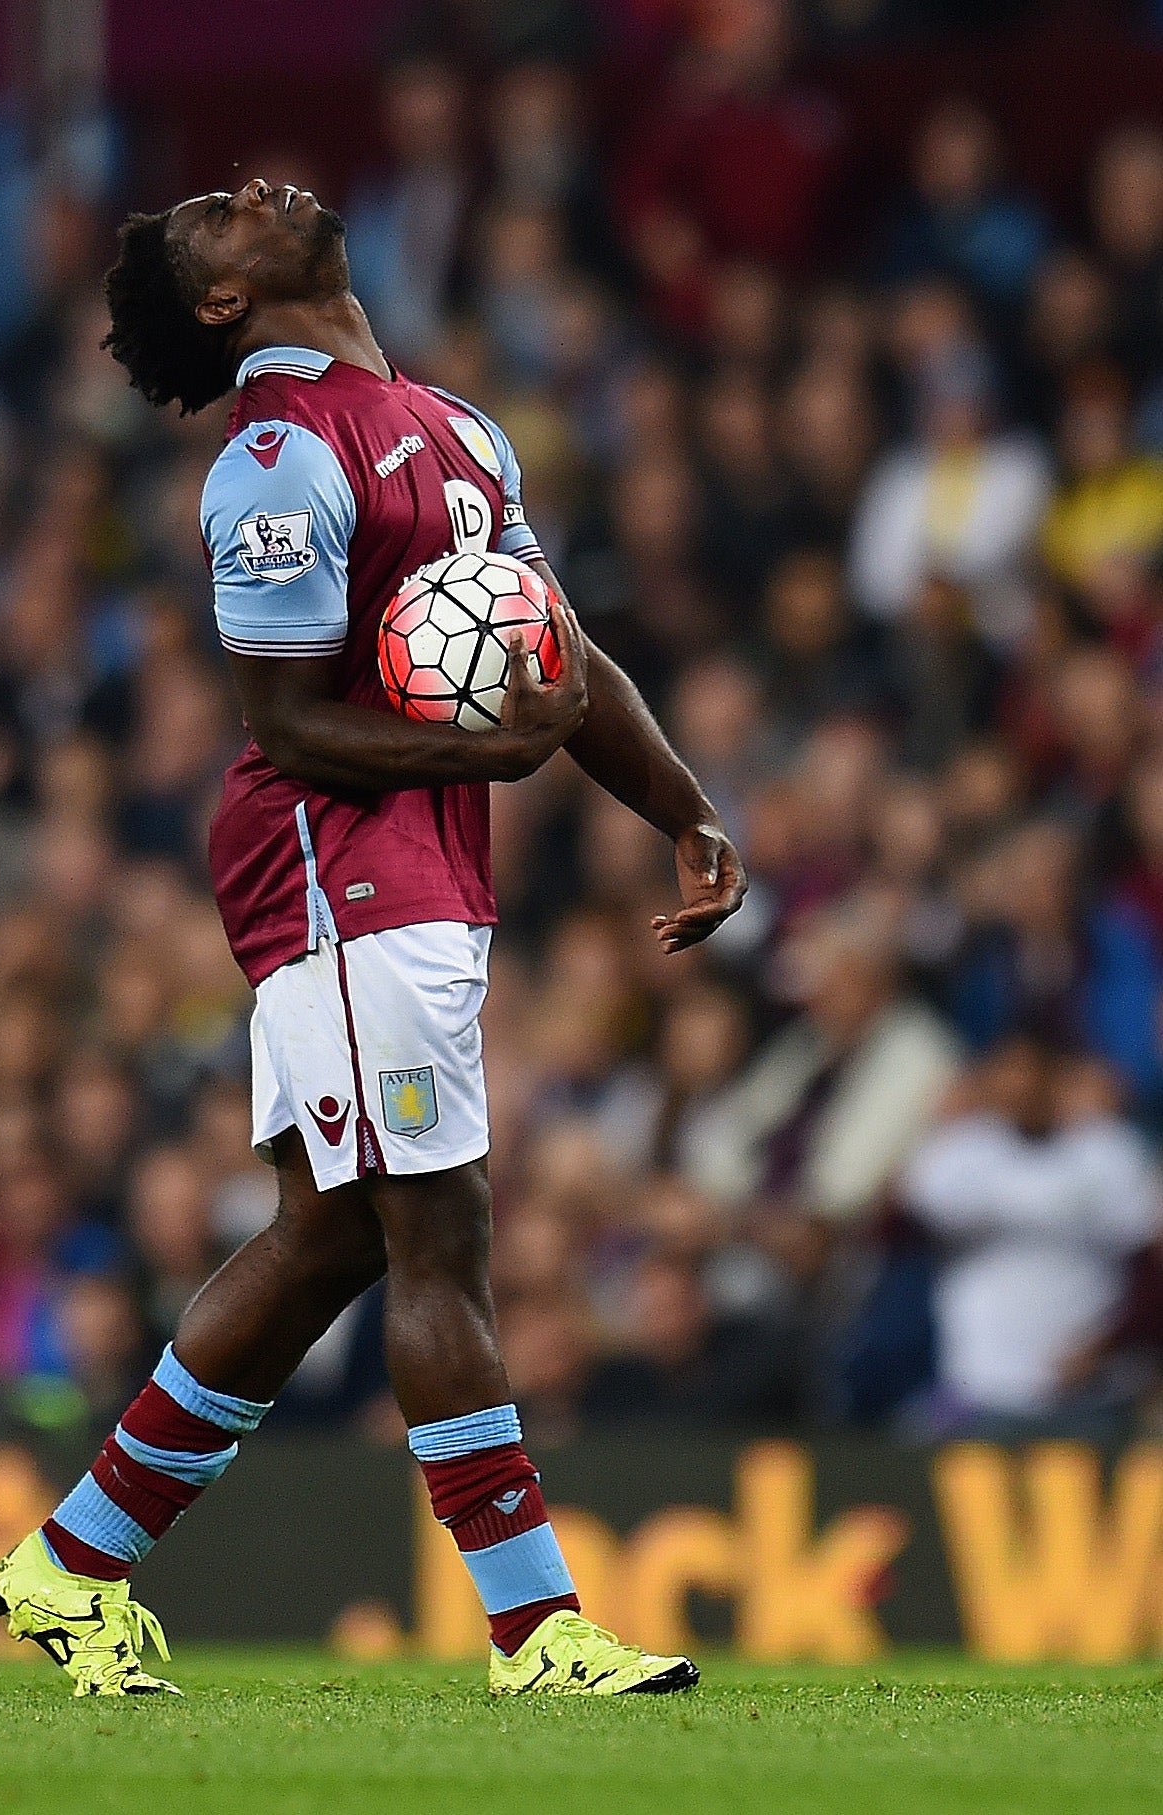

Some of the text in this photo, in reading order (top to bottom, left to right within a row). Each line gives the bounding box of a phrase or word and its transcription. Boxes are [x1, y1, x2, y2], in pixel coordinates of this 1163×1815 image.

[375, 435, 425, 478] macron
[252, 554, 298, 566] BARCLAYS
[385, 1070, 428, 1085] AVFC
